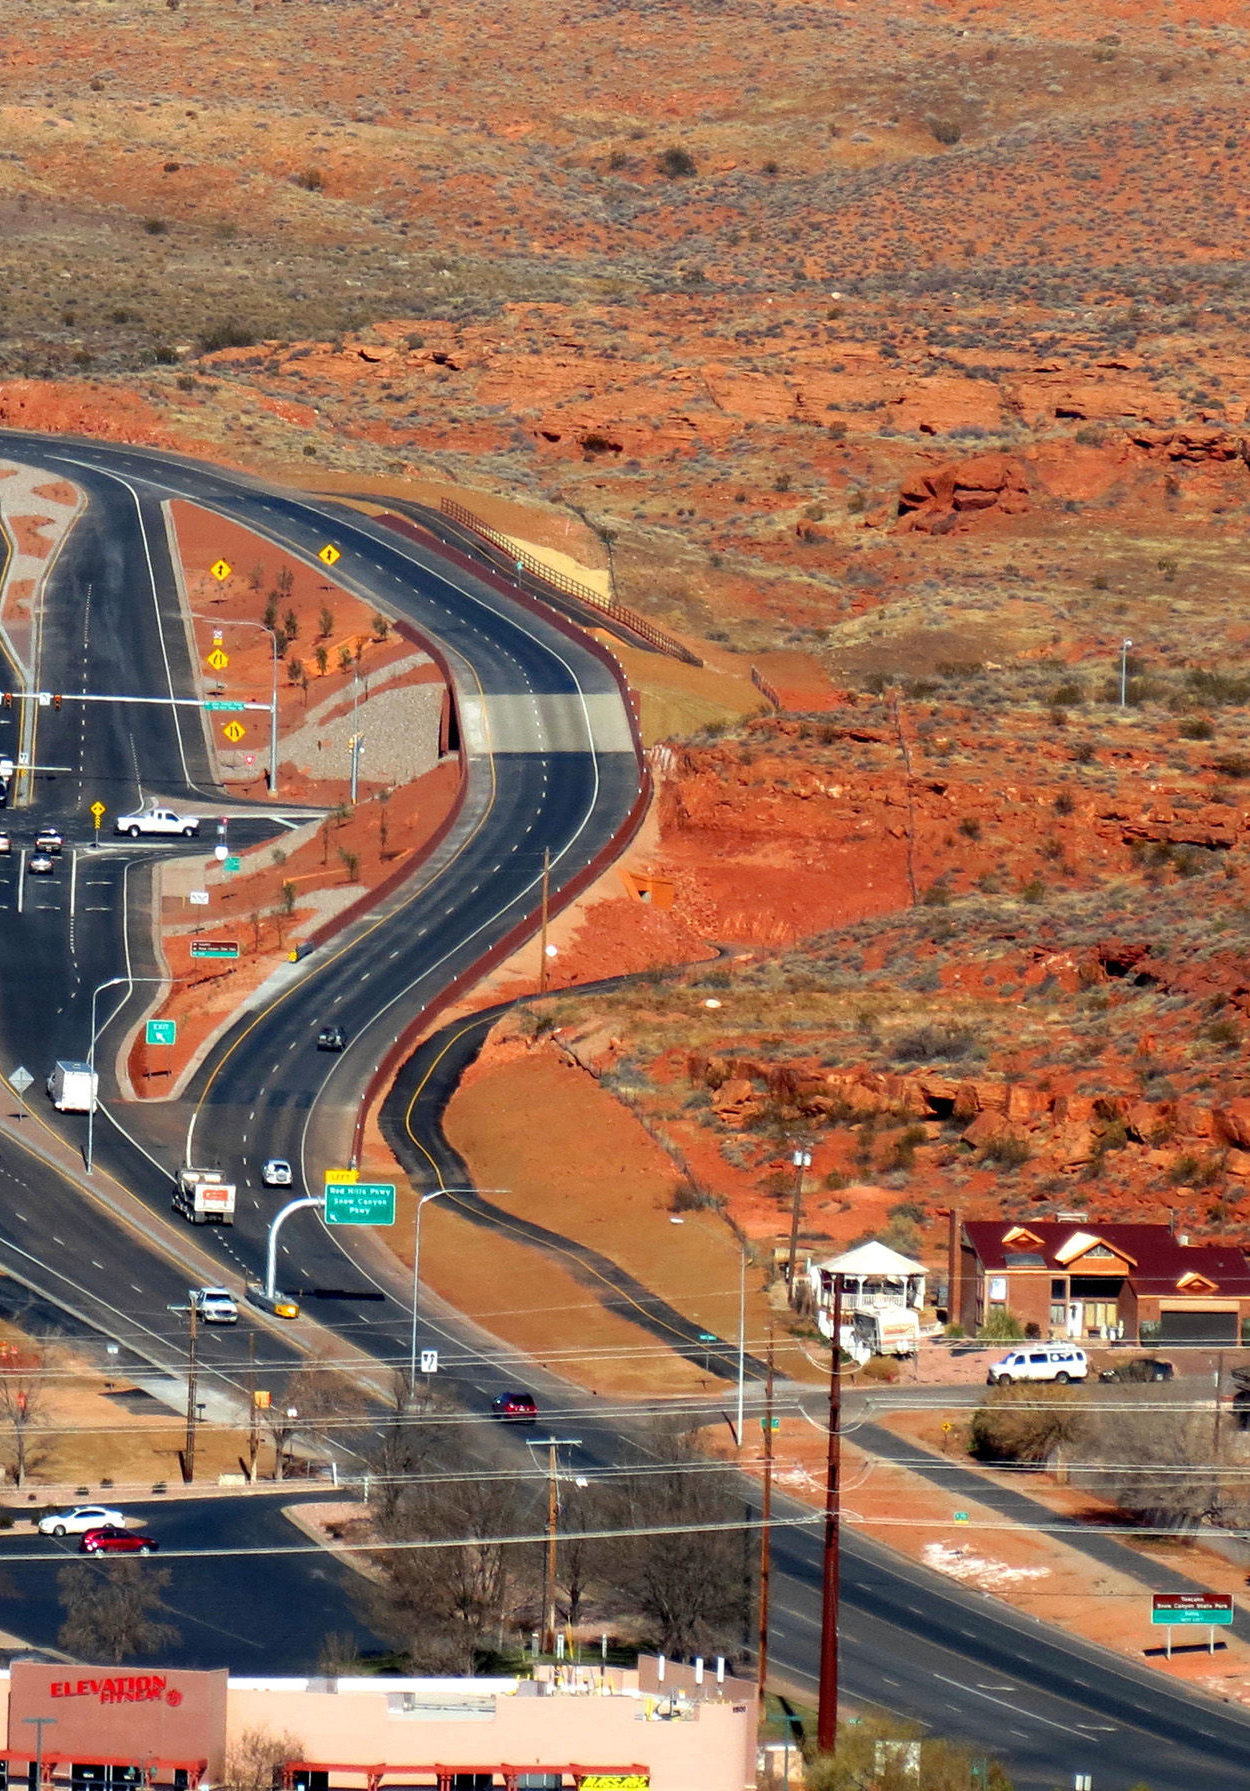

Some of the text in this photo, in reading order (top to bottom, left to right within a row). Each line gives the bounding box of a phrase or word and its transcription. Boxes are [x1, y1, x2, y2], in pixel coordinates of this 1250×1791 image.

[329, 1187, 391, 1196] Red Hills Pkwy
[334, 1197, 387, 1207] Snow Canyon
[349, 1207, 370, 1215] Pkwy
[50, 1675, 167, 1698] ELEVATION
[582, 1776, 649, 1788] MASSAGE
